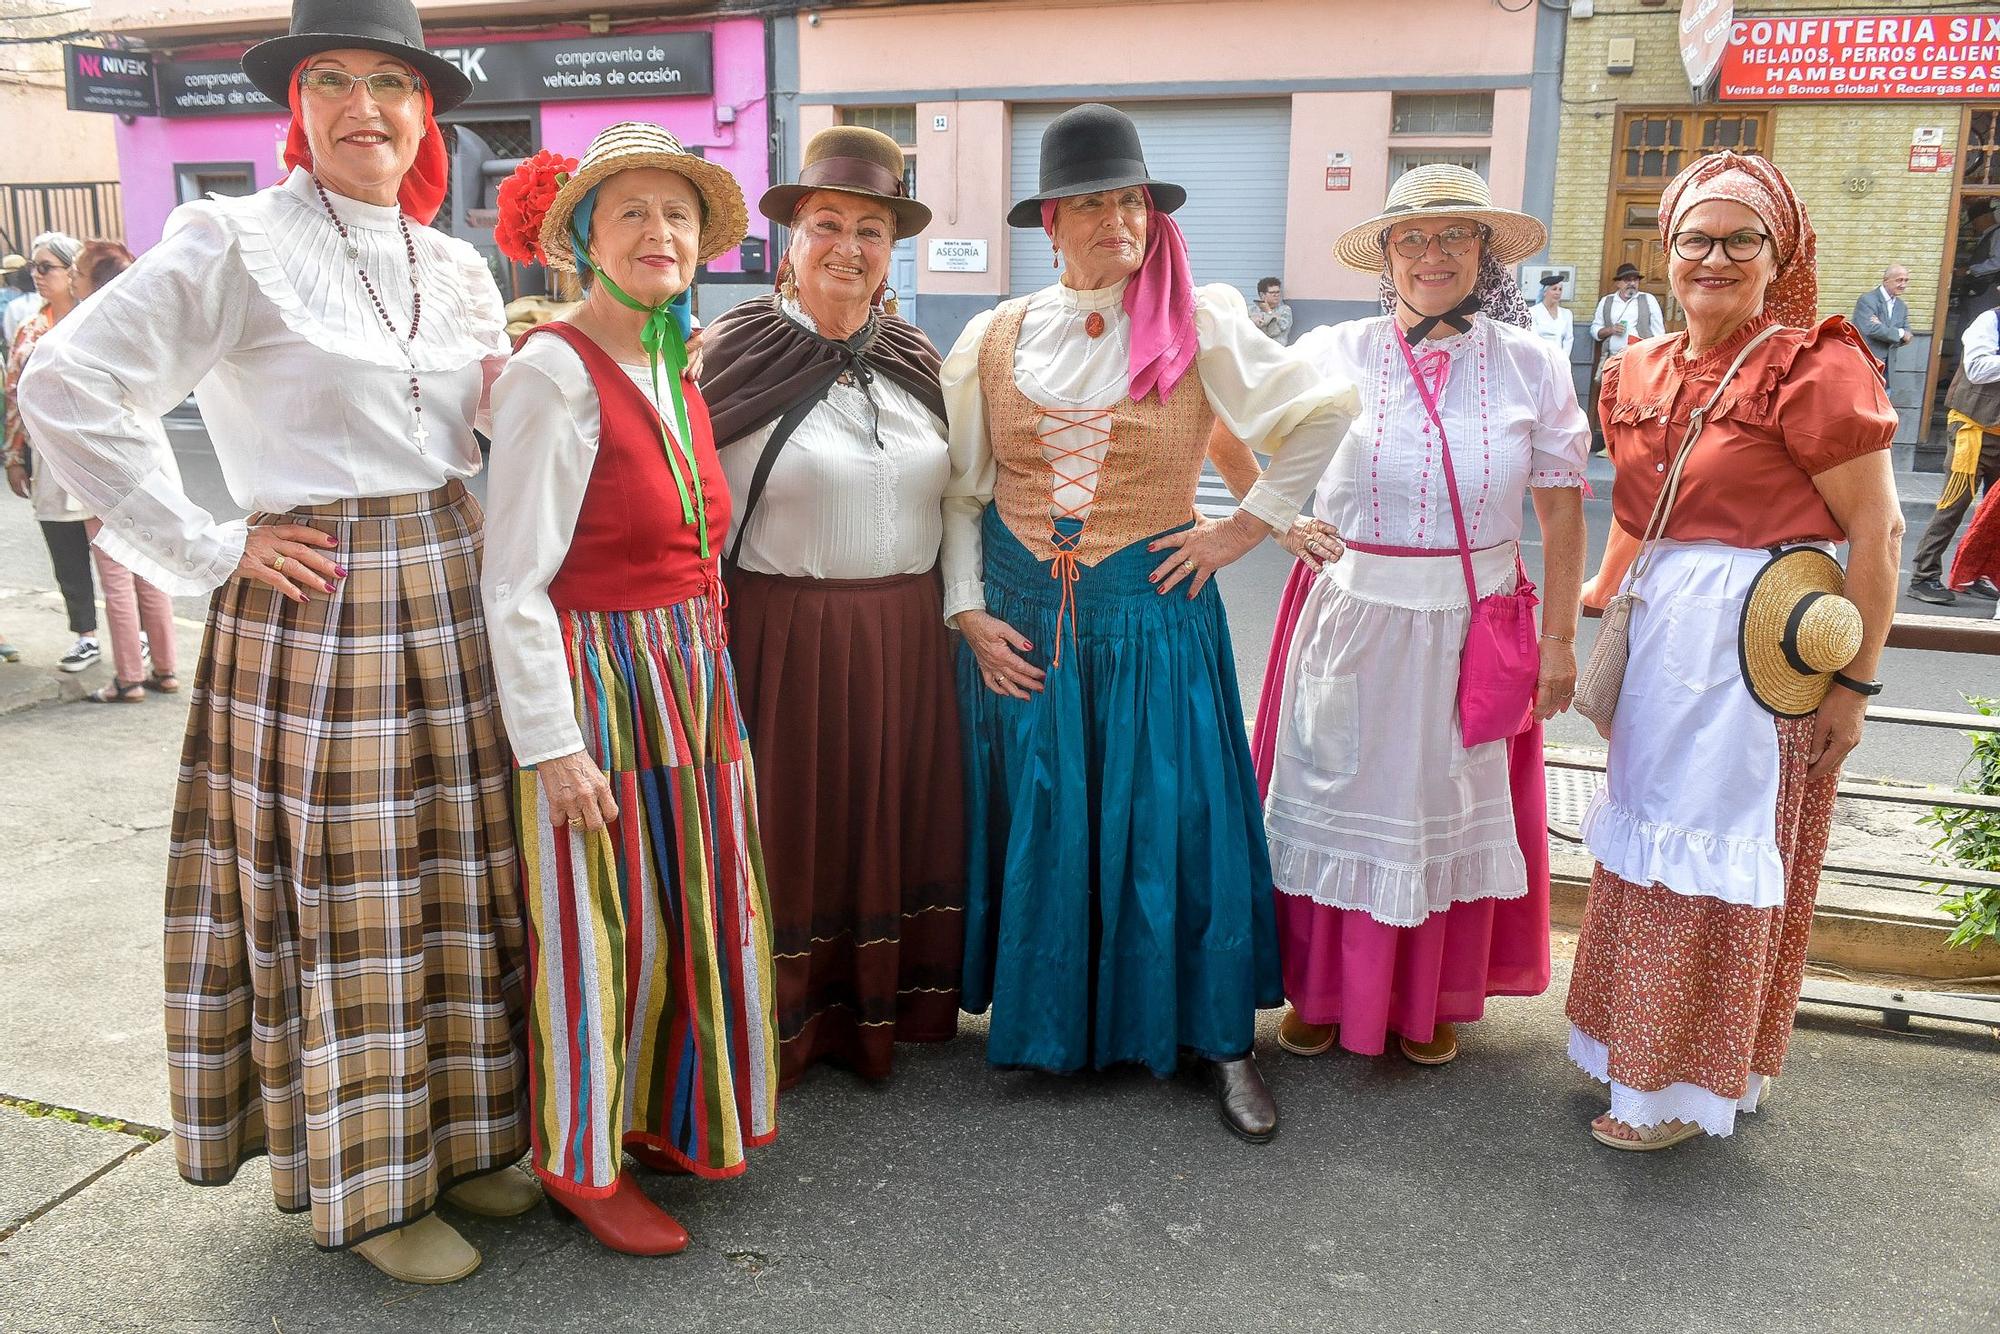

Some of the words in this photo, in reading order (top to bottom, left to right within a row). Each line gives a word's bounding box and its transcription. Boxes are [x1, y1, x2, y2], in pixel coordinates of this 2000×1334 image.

[1730, 19, 1935, 45] CONFITERIA
[1948, 18, 2000, 42] SIX
[555, 47, 642, 68] compraventa
[646, 45, 666, 61] de
[1742, 48, 1834, 66] HELADOS,
[1841, 46, 1916, 63] PERROS
[102, 56, 149, 77] NIVEK
[606, 69, 626, 86] de
[627, 66, 682, 84] ocasión
[228, 90, 244, 104] de
[1726, 85, 1764, 95] Venta
[1767, 85, 1785, 95] de
[1788, 84, 1831, 94] Bonos
[1834, 83, 1878, 94] Global
[1882, 83, 1893, 93] Y
[1895, 83, 1962, 95] Recargas
[1966, 82, 1984, 93] de
[1850, 177, 1868, 192] 33
[936, 246, 979, 257] ASESORÍA
